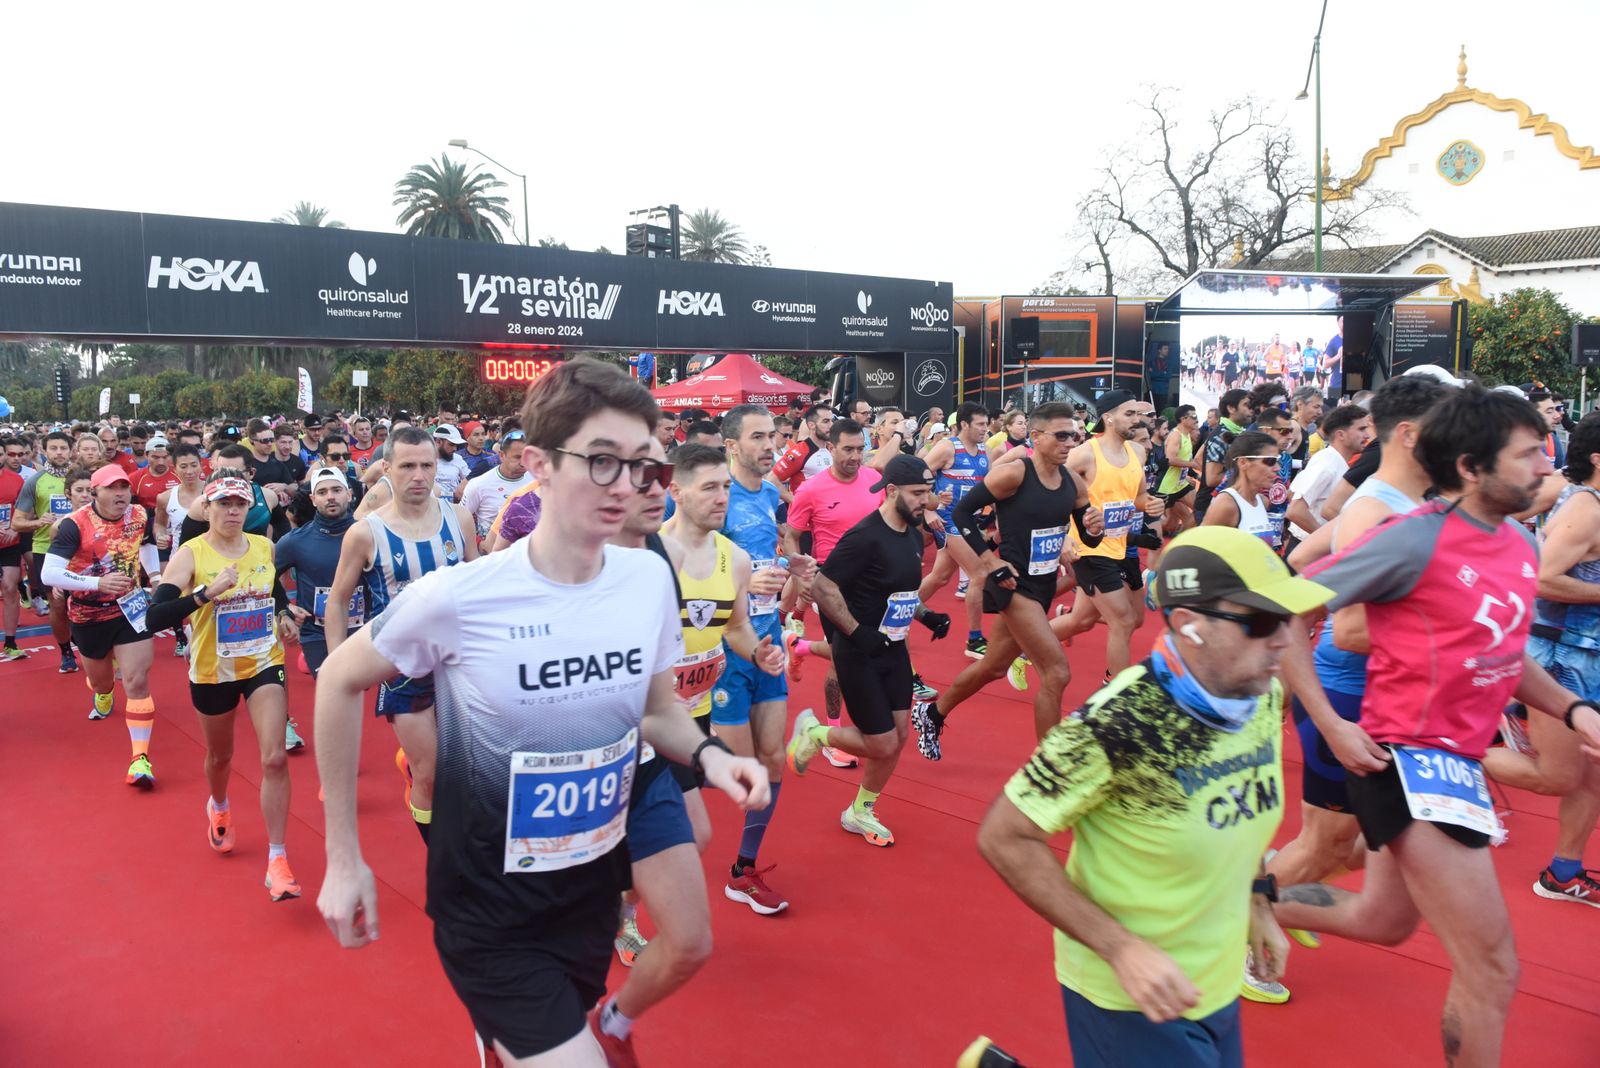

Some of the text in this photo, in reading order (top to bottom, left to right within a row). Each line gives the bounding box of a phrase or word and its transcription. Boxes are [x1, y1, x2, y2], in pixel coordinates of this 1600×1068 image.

[46, 275, 82, 286] Motor
[147, 256, 265, 293] HOKA
[491, 274, 599, 300] maratón
[326, 307, 402, 319] Healthcare Partner
[521, 296, 600, 320] sevilla
[658, 290, 722, 316] HOKA
[772, 302, 816, 314] HYUNDAI
[507, 323, 583, 337] 28 enero 2024
[772, 314, 816, 324] Hyundauto Motor
[485, 360, 551, 380] 00:00:
[509, 623, 552, 640] GOBIK
[518, 647, 643, 692] LEPAPE
[677, 663, 715, 690] 1407
[572, 690, 584, 701] DE
[588, 685, 616, 698] VOTRE
[1413, 753, 1474, 788] 3106
[531, 771, 618, 819] 2019
[1207, 776, 1279, 830] CXM
